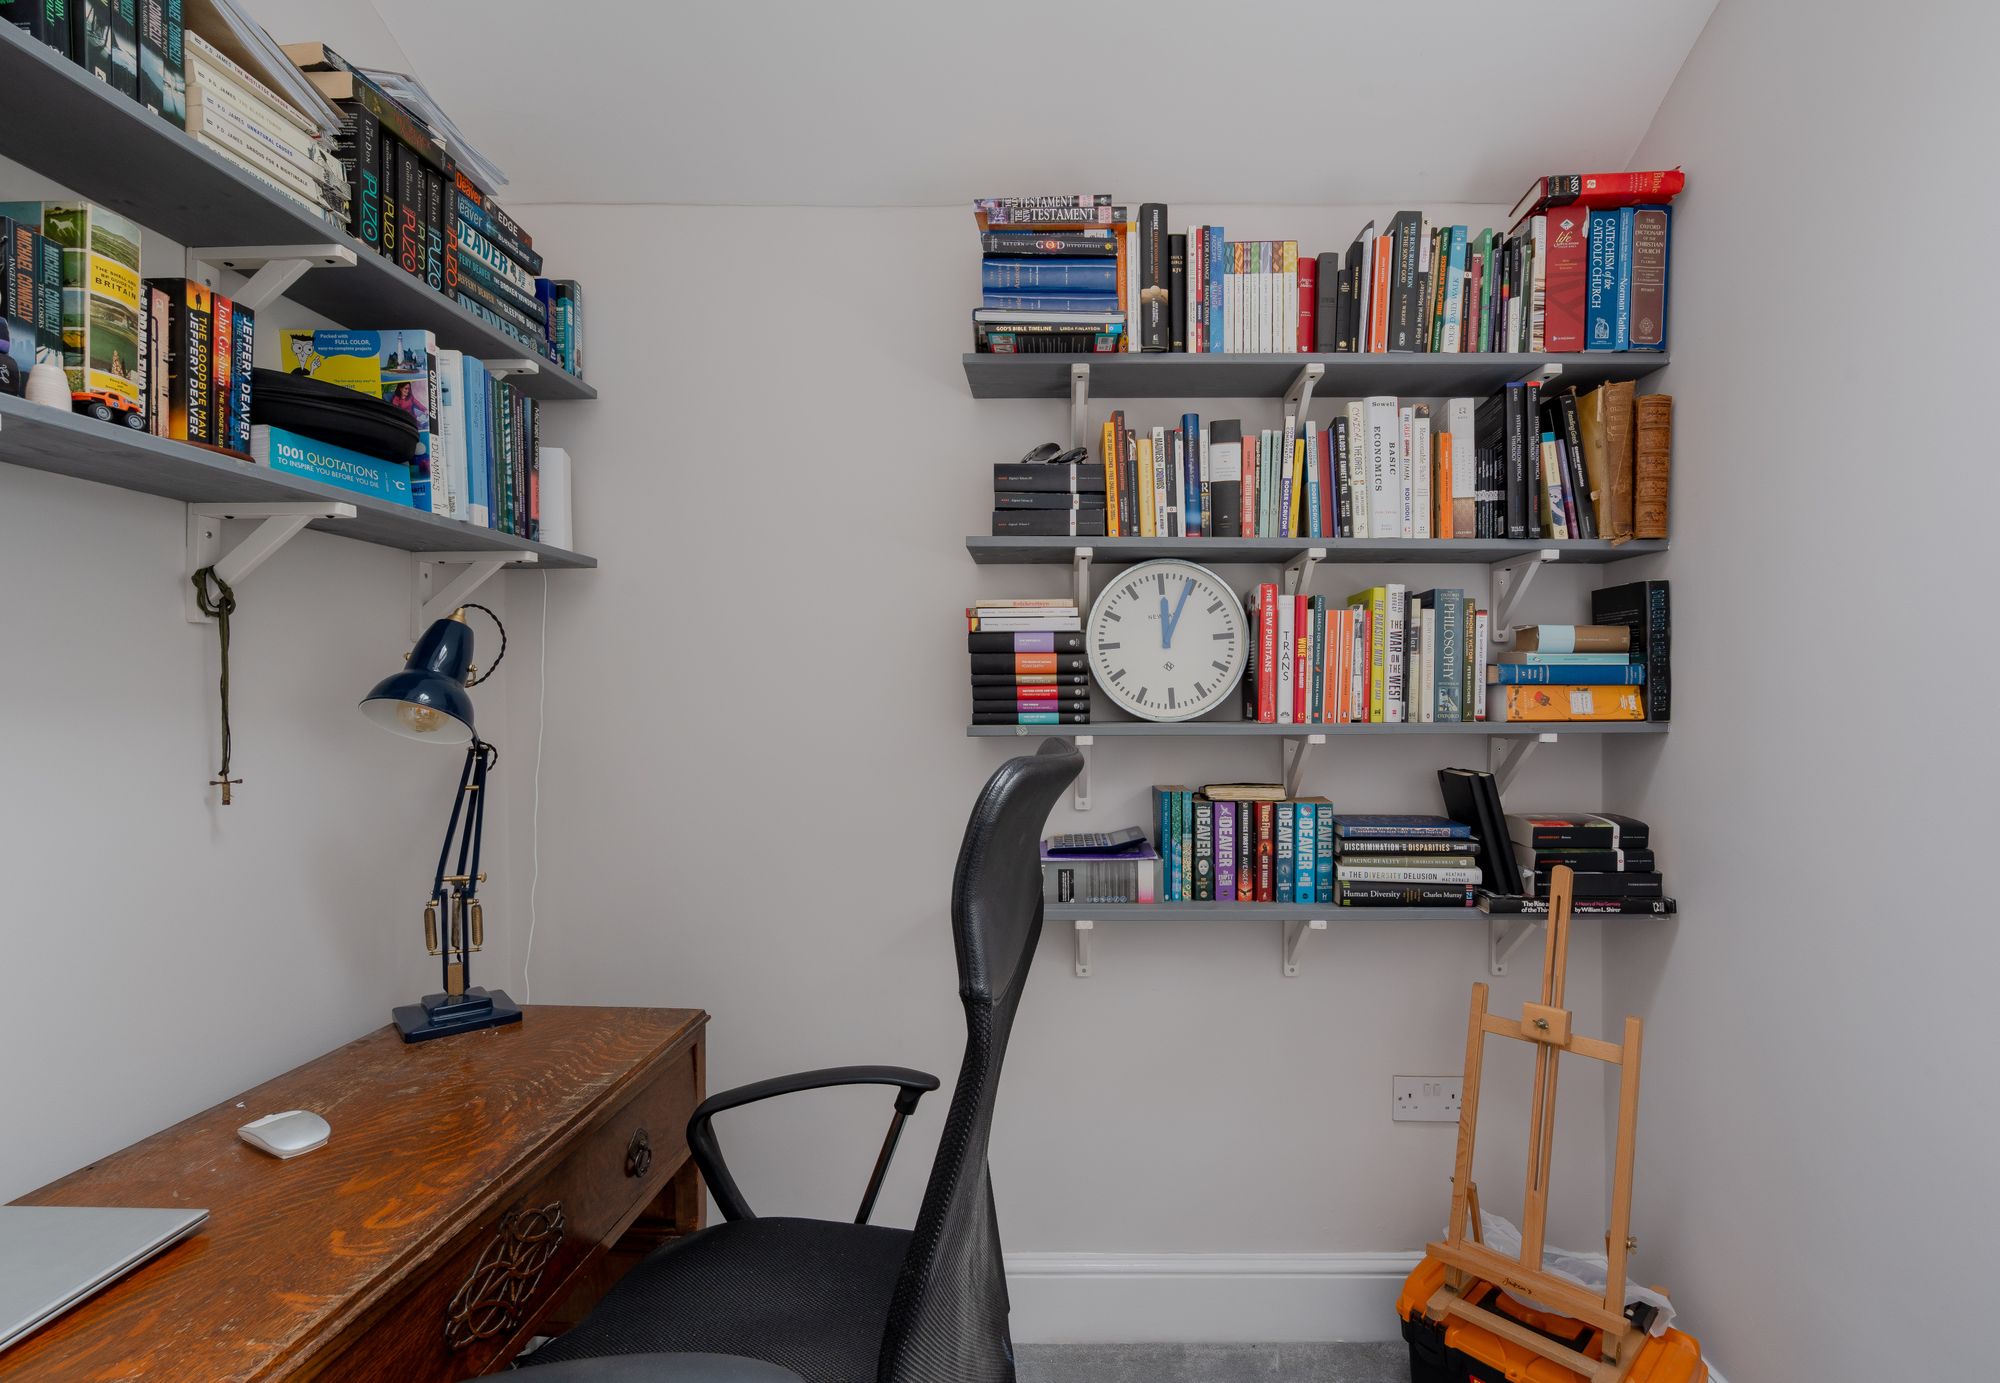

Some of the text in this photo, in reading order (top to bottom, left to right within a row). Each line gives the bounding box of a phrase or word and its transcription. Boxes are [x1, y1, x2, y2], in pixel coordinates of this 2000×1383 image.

[169, 21, 181, 67] CONNELLY
[246, 122, 275, 146] UNNATURAL
[363, 172, 378, 241] PUZO
[384, 199, 394, 249] PUZO
[498, 212, 518, 236] EDGE
[1014, 210, 1022, 222] THE
[1019, 196, 1074, 208] TESTAMENT
[1031, 208, 1095, 220] TESTAMENT
[402, 208, 416, 272] PUZO
[428, 232, 442, 291] PUZO
[446, 229, 458, 286] PUZO
[1556, 231, 1572, 243] life
[1604, 218, 1616, 270] CATECHISM
[8, 255, 16, 318] ANGELS FLIGHT
[16, 228, 33, 324] MICHAEL CONNELLY
[1408, 237, 1416, 288] RESURRECTION
[1592, 218, 1603, 308] CATHOLIC CHURCH
[44, 244, 60, 336] MICHAEL CONNELLY
[96, 277, 136, 300] BRITAIN
[1437, 286, 1445, 316] BIBLICAL
[1450, 301, 1458, 324] DAILY
[1619, 278, 1628, 310] Norman
[218, 302, 229, 388] John Grisham
[1618, 312, 1626, 344] Mathers
[190, 313, 200, 435] JEFFERY DEAVER
[198, 316, 207, 438] THE GOODBYE MAN
[240, 317, 253, 441] JEFFERY DEAVER
[1568, 410, 1578, 431] Reading
[277, 444, 379, 481] 1001 QUOTATIONS
[278, 456, 368, 486] TO INSPIRE YOU BEFORE YOU
[1155, 438, 1165, 489] MADNESS CROWDS
[1354, 445, 1364, 475] THEORIES
[1374, 426, 1382, 492] ECONOMICS
[1264, 629, 1273, 672] PURITANS
[1282, 632, 1290, 681] TRANS
[1298, 638, 1306, 658] WOKE
[1374, 600, 1384, 666] THE PARASITIC MIND
[1443, 604, 1454, 680] PHILOSOPHY
[1388, 620, 1402, 702] THE WAR THE WEST
[1197, 809, 1210, 857] DEAVER
[1218, 817, 1232, 867] DEAVER
[1279, 808, 1293, 858] DEAVER
[1299, 818, 1314, 870] DEAVER
[1318, 808, 1332, 858] DEAVER
[1344, 842, 1450, 852] DISCRIMINATION DISPARITIES
[1370, 890, 1400, 899] Diversity
[1443, 892, 1462, 900] Murray
